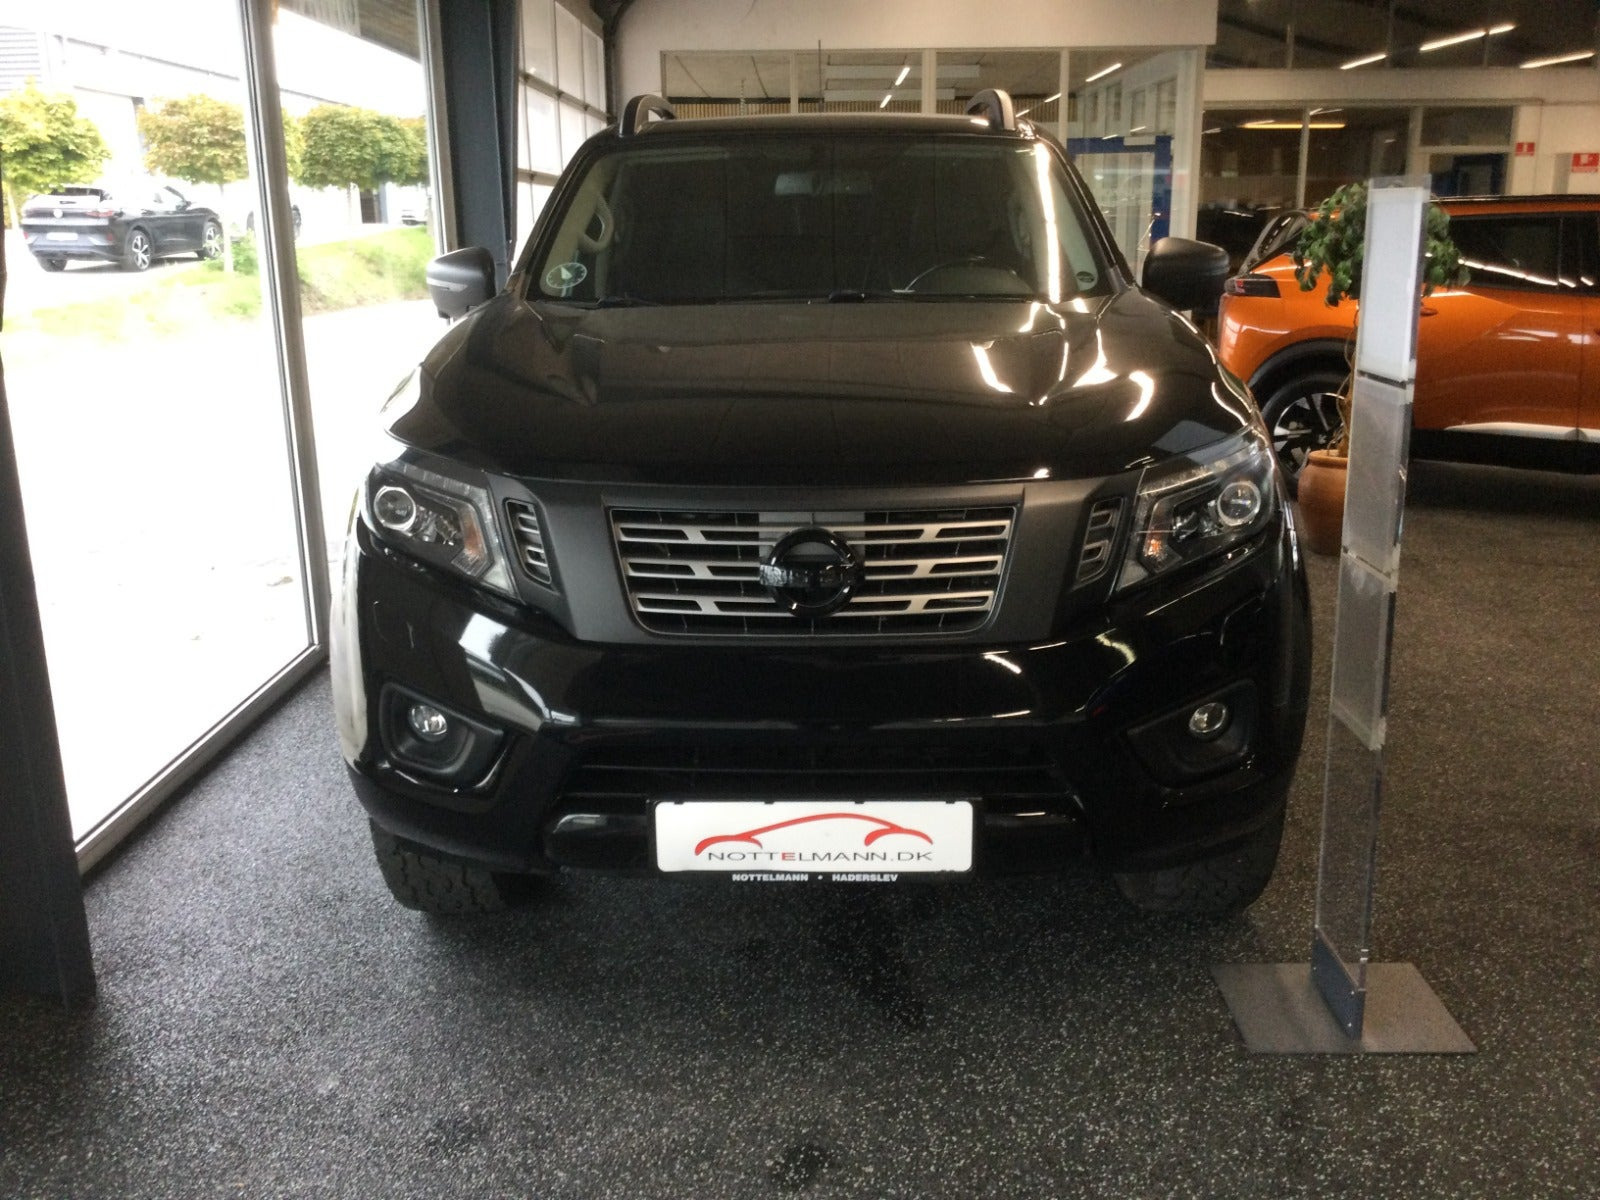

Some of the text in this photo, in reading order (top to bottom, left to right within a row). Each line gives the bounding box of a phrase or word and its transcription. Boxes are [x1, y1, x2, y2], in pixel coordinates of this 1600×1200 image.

[708, 852, 933, 861] NOTTELMANN.DK
[732, 873, 898, 882] NOTTELMANN HADERSLEV
